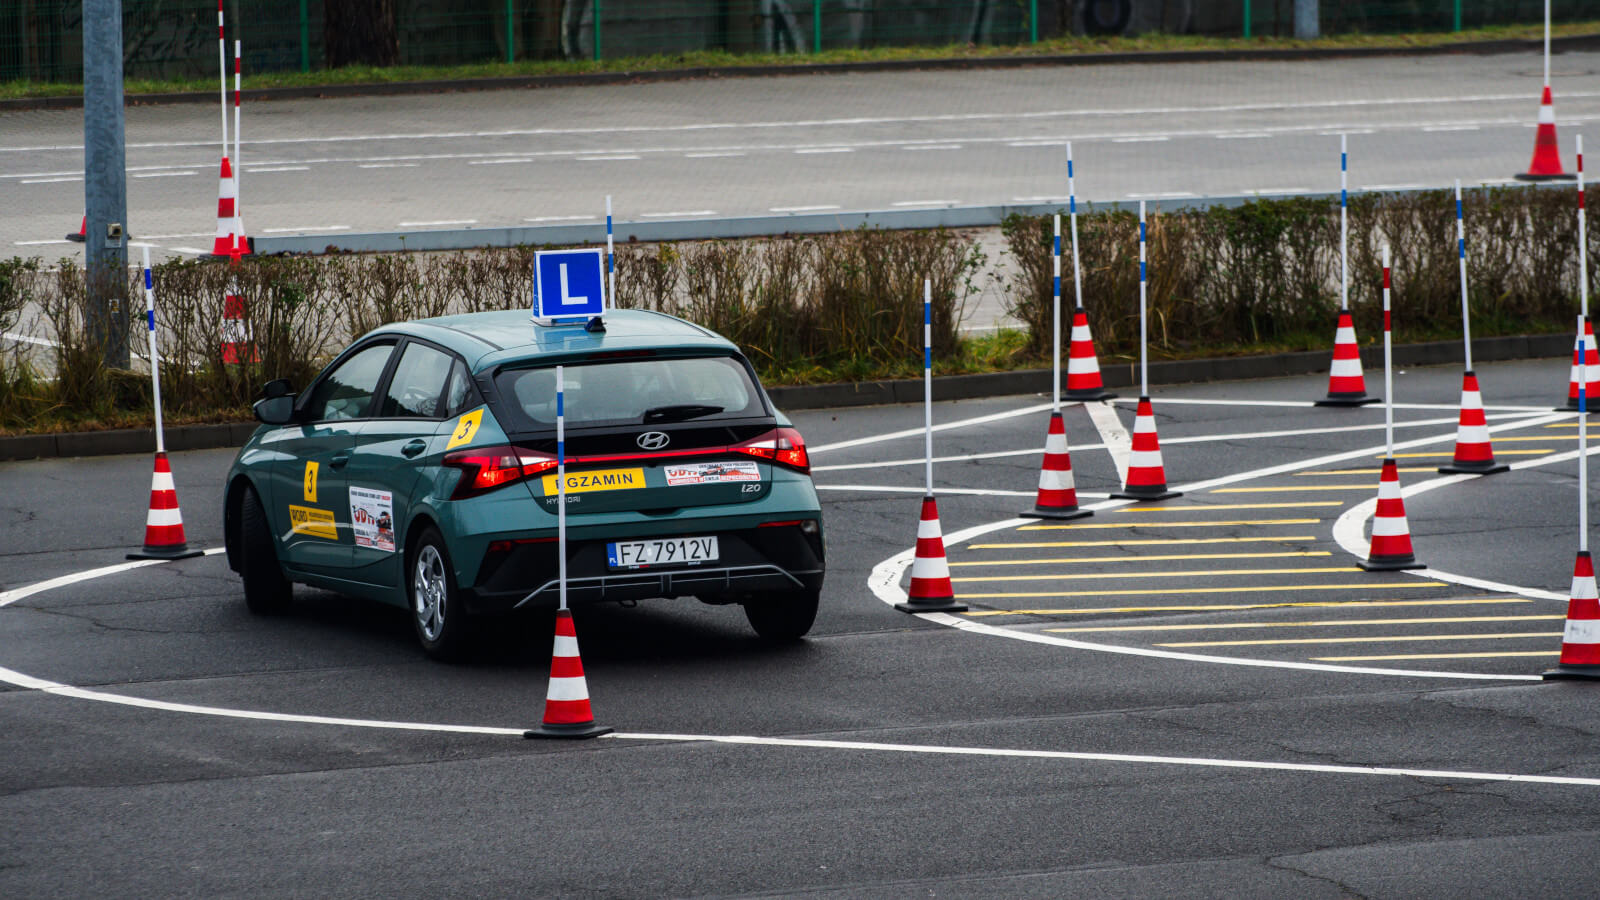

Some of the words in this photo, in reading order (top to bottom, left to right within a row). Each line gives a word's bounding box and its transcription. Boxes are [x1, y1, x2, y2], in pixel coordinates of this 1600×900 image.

[560, 263, 588, 305] L
[458, 420, 472, 440] 3
[307, 470, 314, 494] 3
[546, 495, 581, 505] HYDAI
[291, 508, 308, 522] WORD
[620, 543, 646, 564] FZ
[653, 538, 712, 562] 7912V
